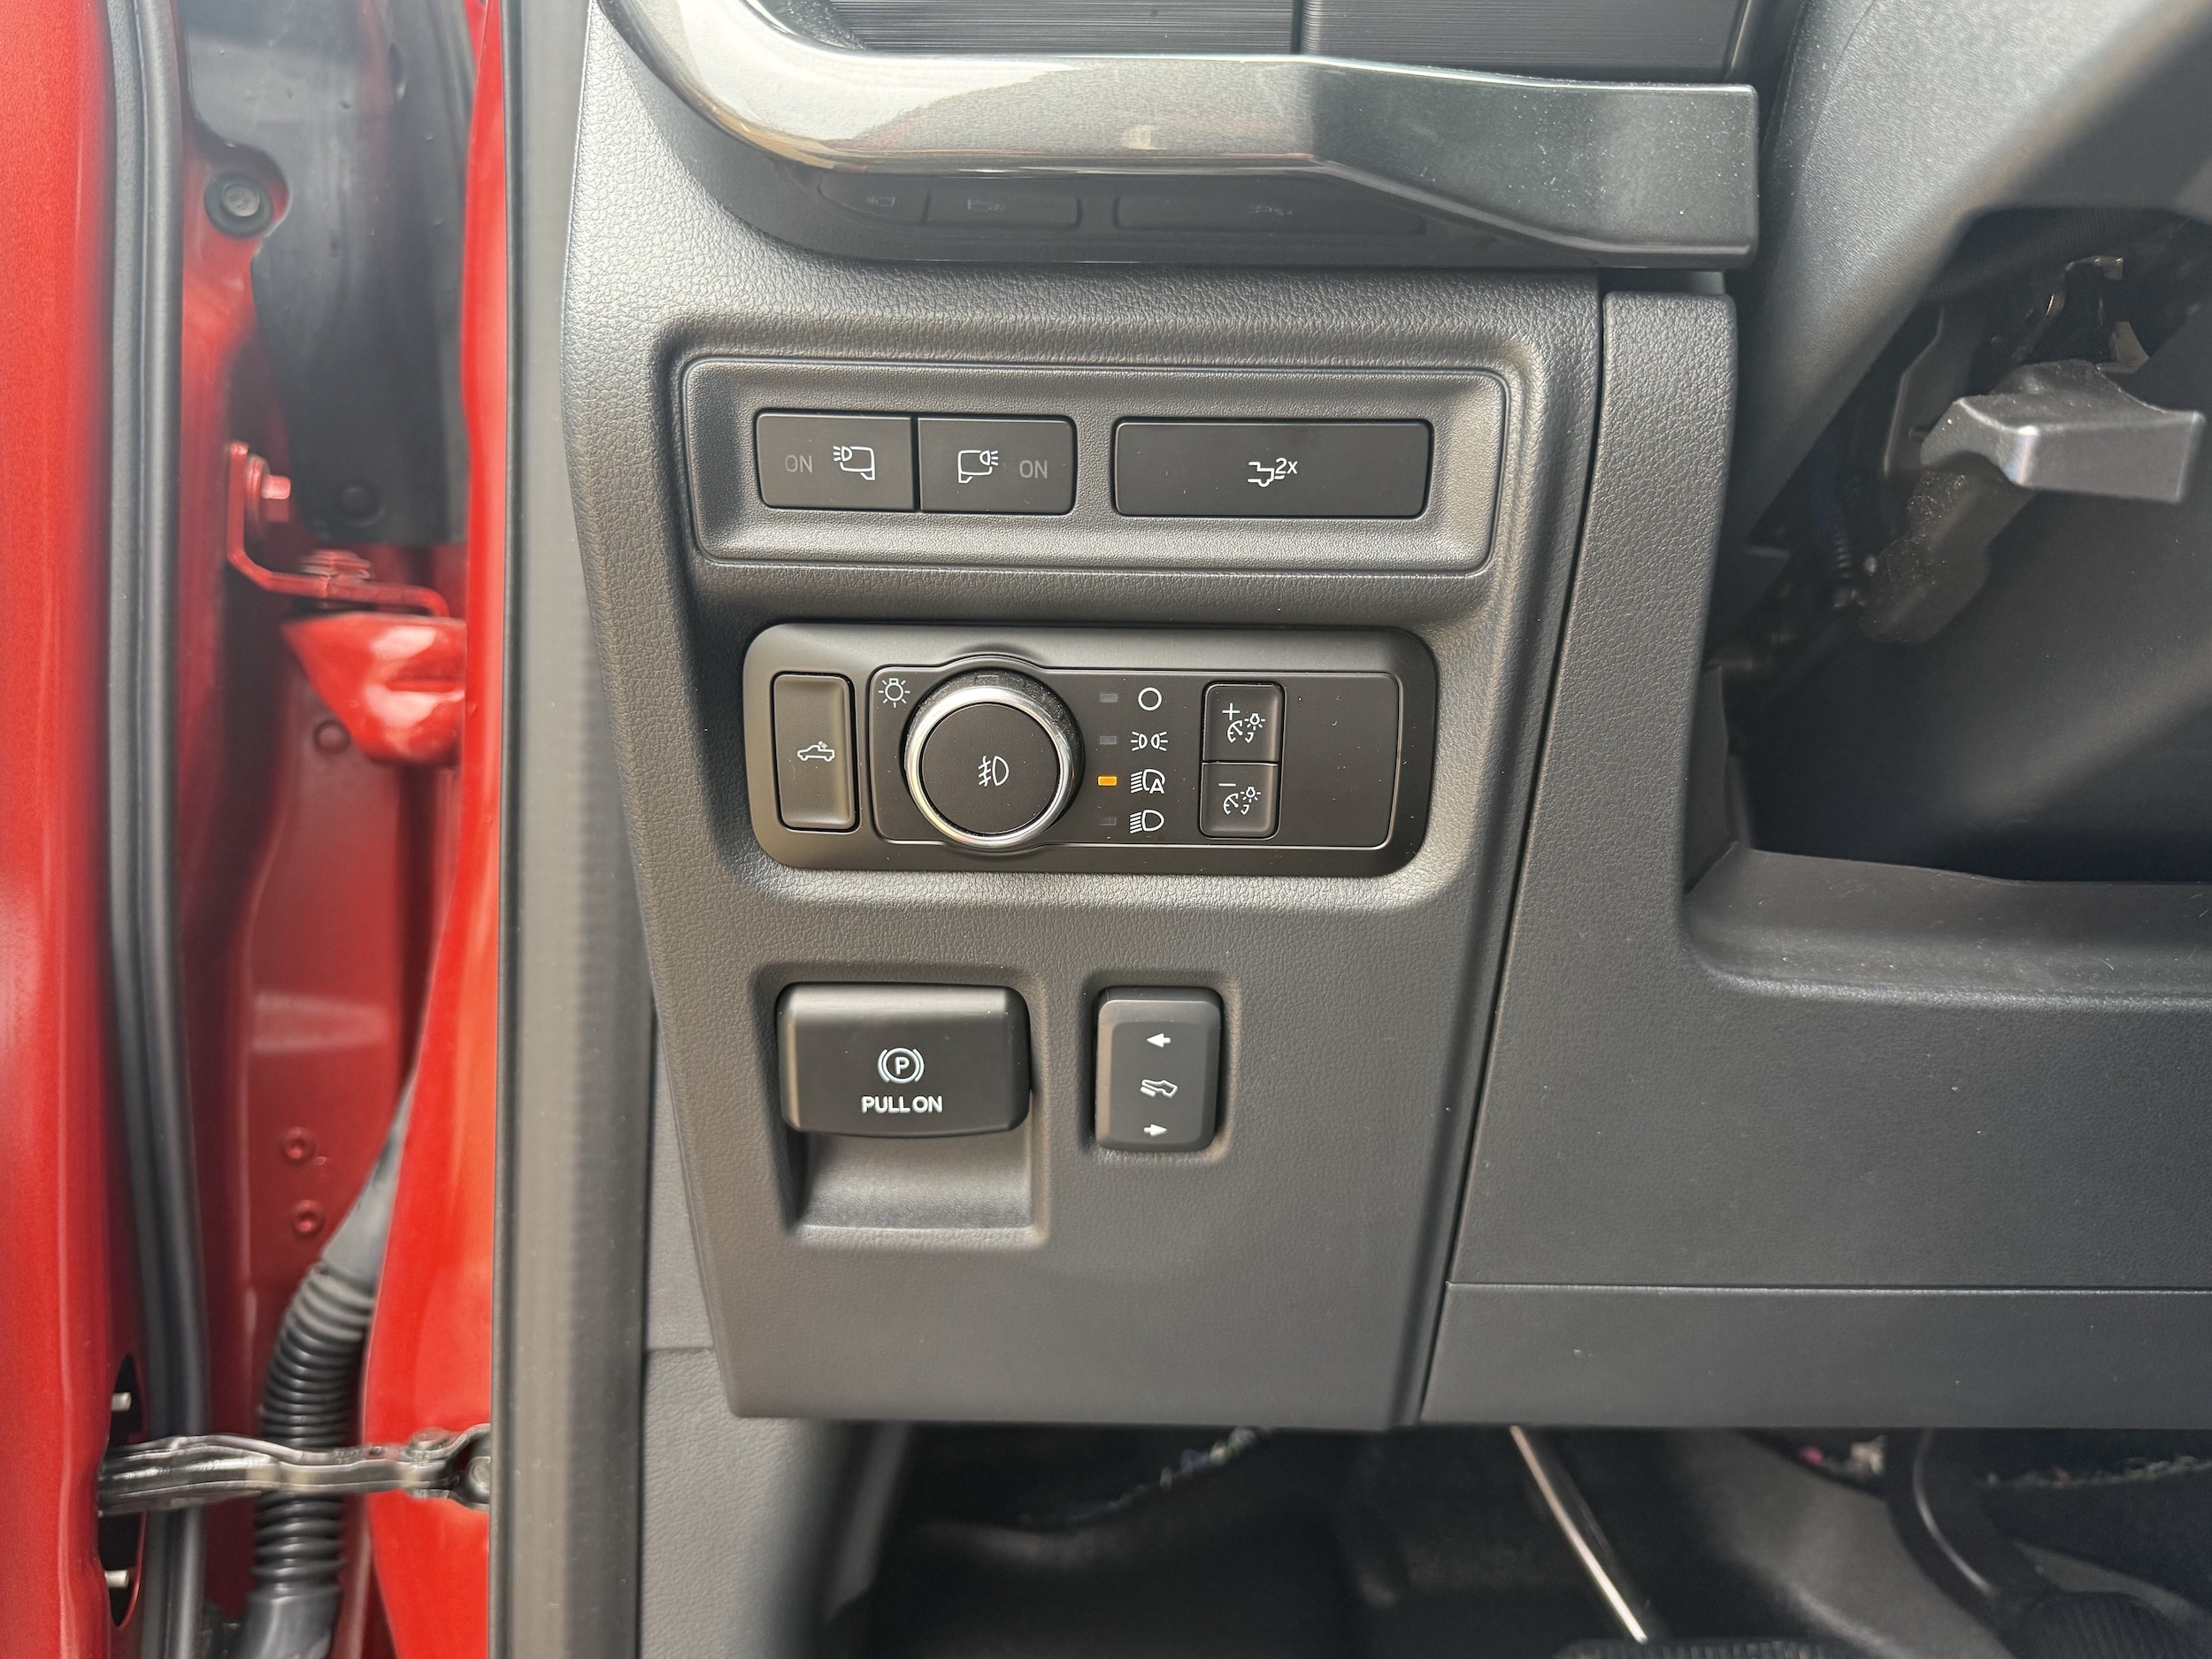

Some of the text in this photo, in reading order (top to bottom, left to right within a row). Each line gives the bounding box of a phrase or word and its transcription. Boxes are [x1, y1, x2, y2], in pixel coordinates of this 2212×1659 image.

[785, 455, 813, 473] ON
[1019, 459, 1048, 479] ON
[895, 1056, 910, 1076] P
[861, 1095, 943, 1113] PULL ON
